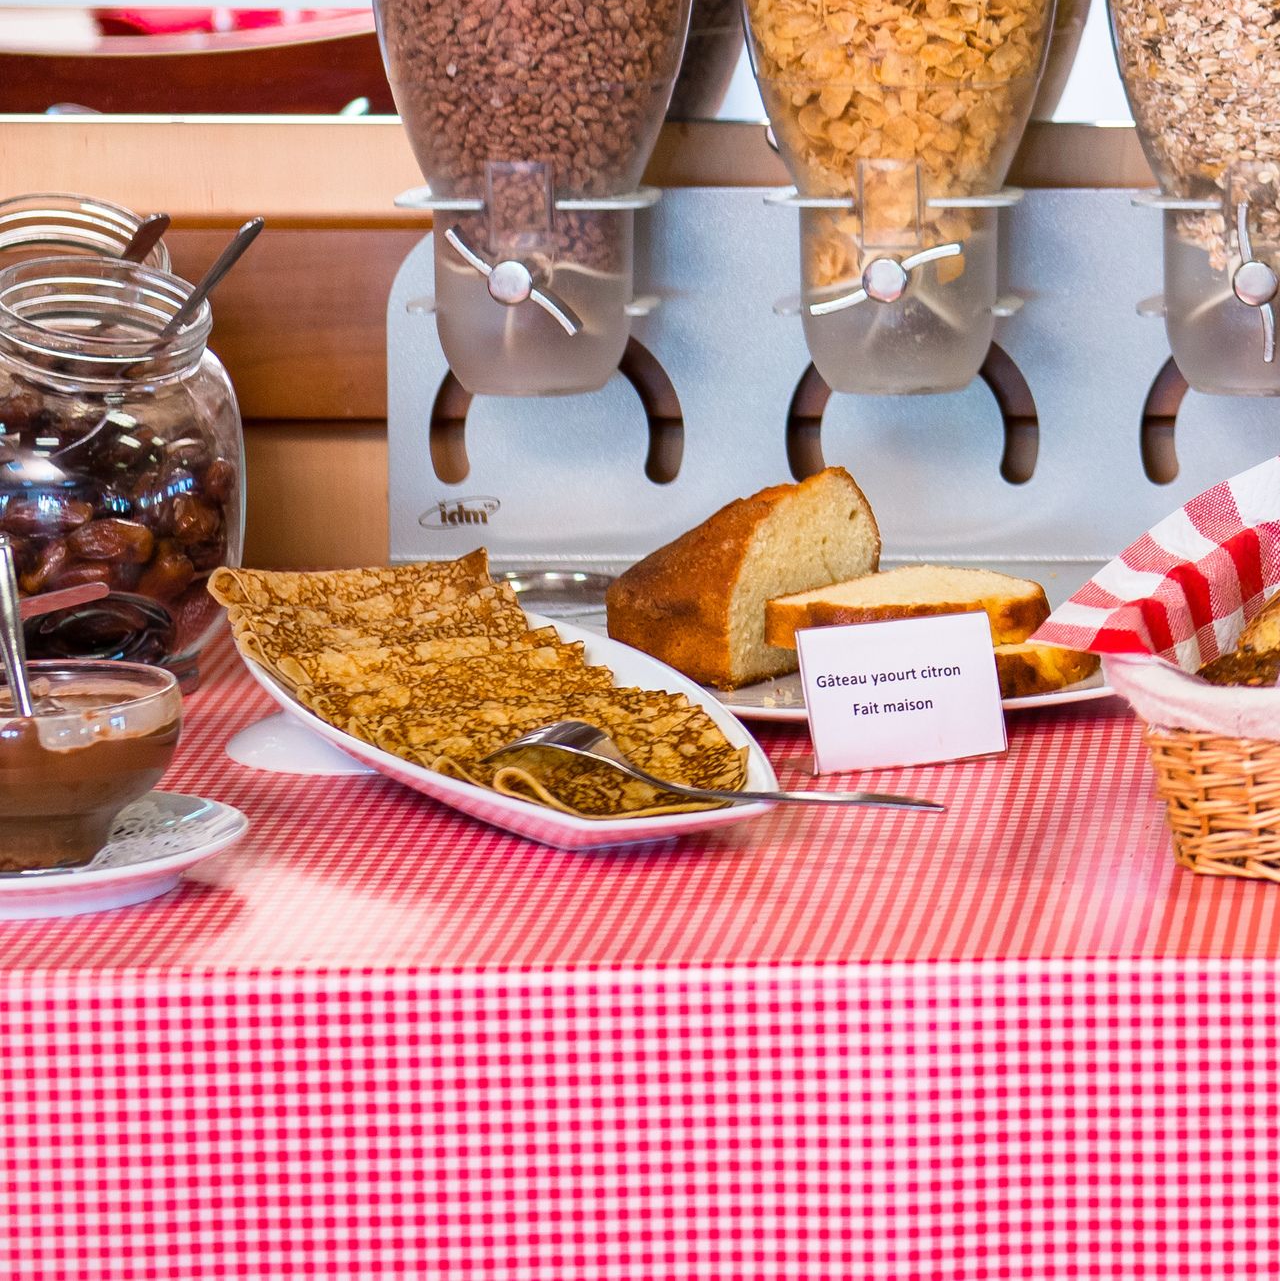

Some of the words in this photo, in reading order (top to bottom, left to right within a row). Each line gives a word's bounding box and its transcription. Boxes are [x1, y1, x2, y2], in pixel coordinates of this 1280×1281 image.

[816, 673, 867, 689] Gâteau
[871, 668, 917, 686] yaourt
[920, 664, 961, 679] citron
[853, 701, 880, 716] Fait
[883, 698, 933, 714] maison
